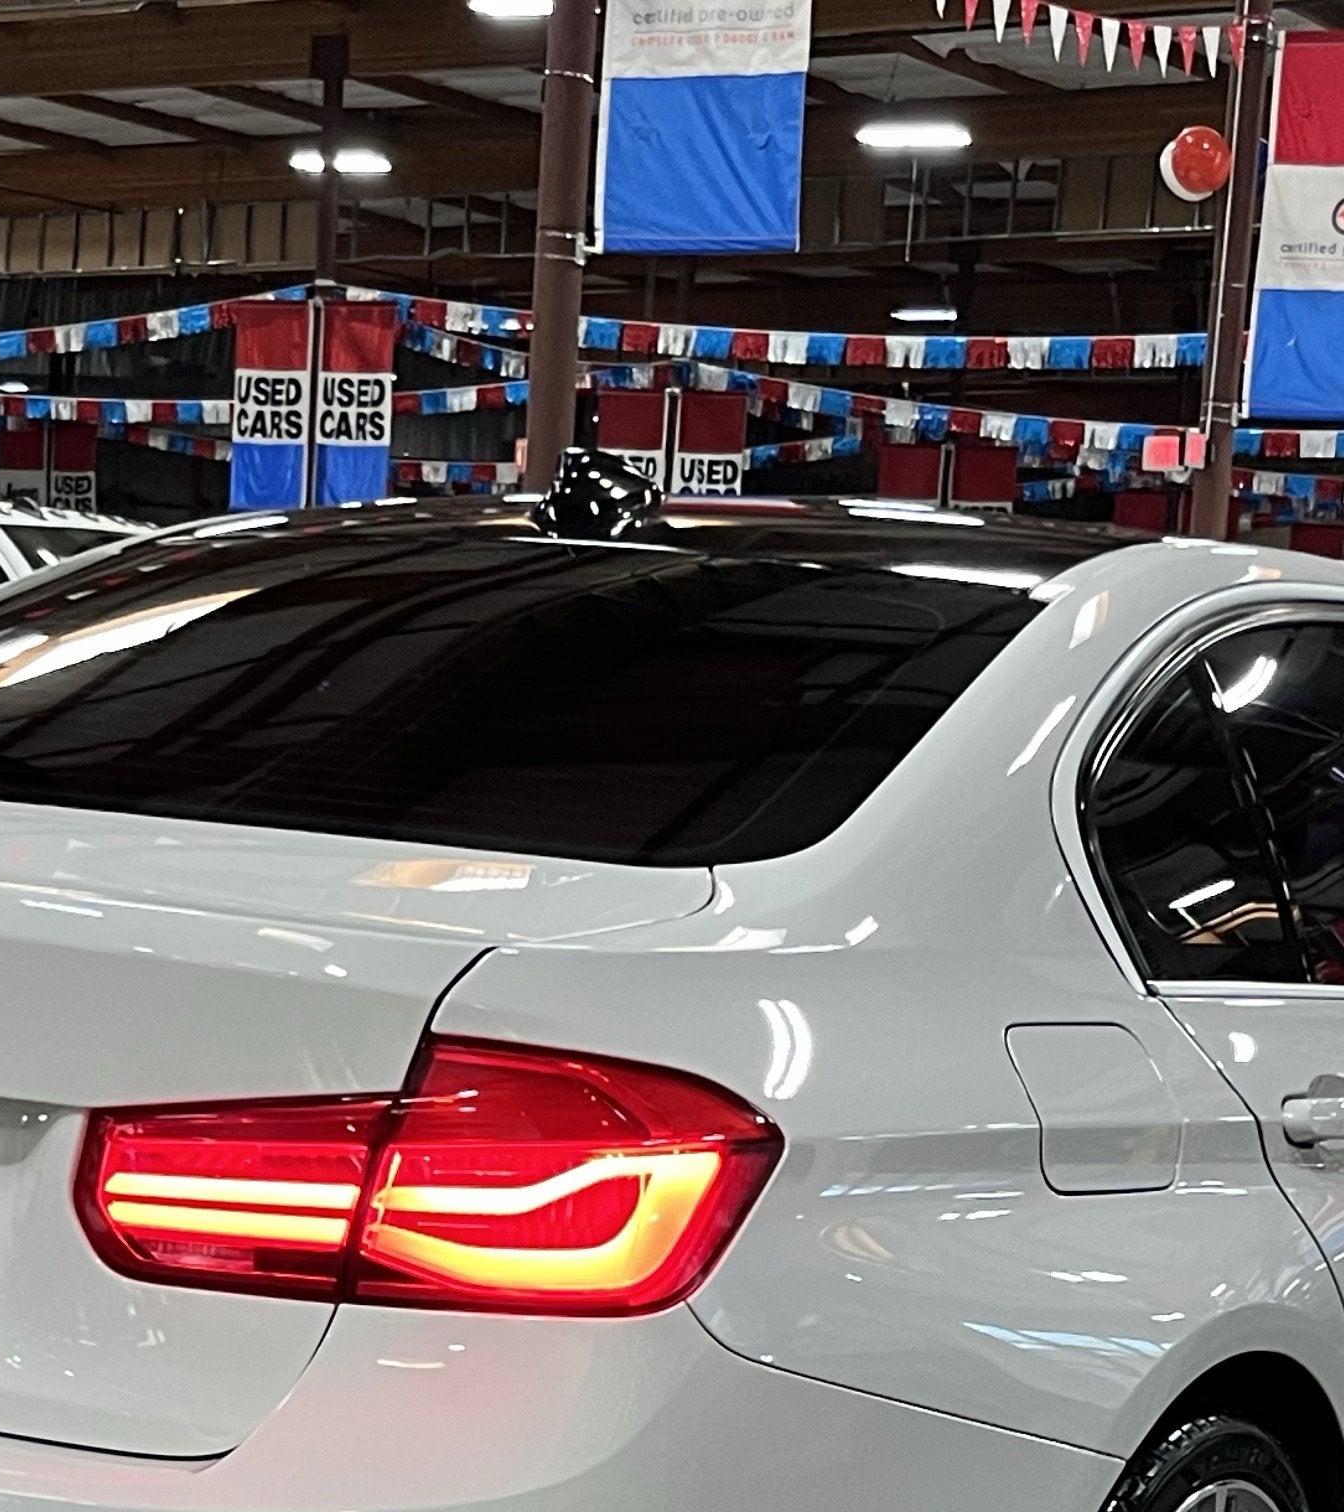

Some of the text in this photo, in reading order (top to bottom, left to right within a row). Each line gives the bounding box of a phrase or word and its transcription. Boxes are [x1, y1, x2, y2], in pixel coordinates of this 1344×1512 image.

[238, 376, 302, 406] USED
[323, 377, 385, 407] USED
[237, 408, 303, 439] CARS
[320, 410, 385, 440] CARS
[55, 475, 92, 496] USED
[680, 457, 738, 485] USED
